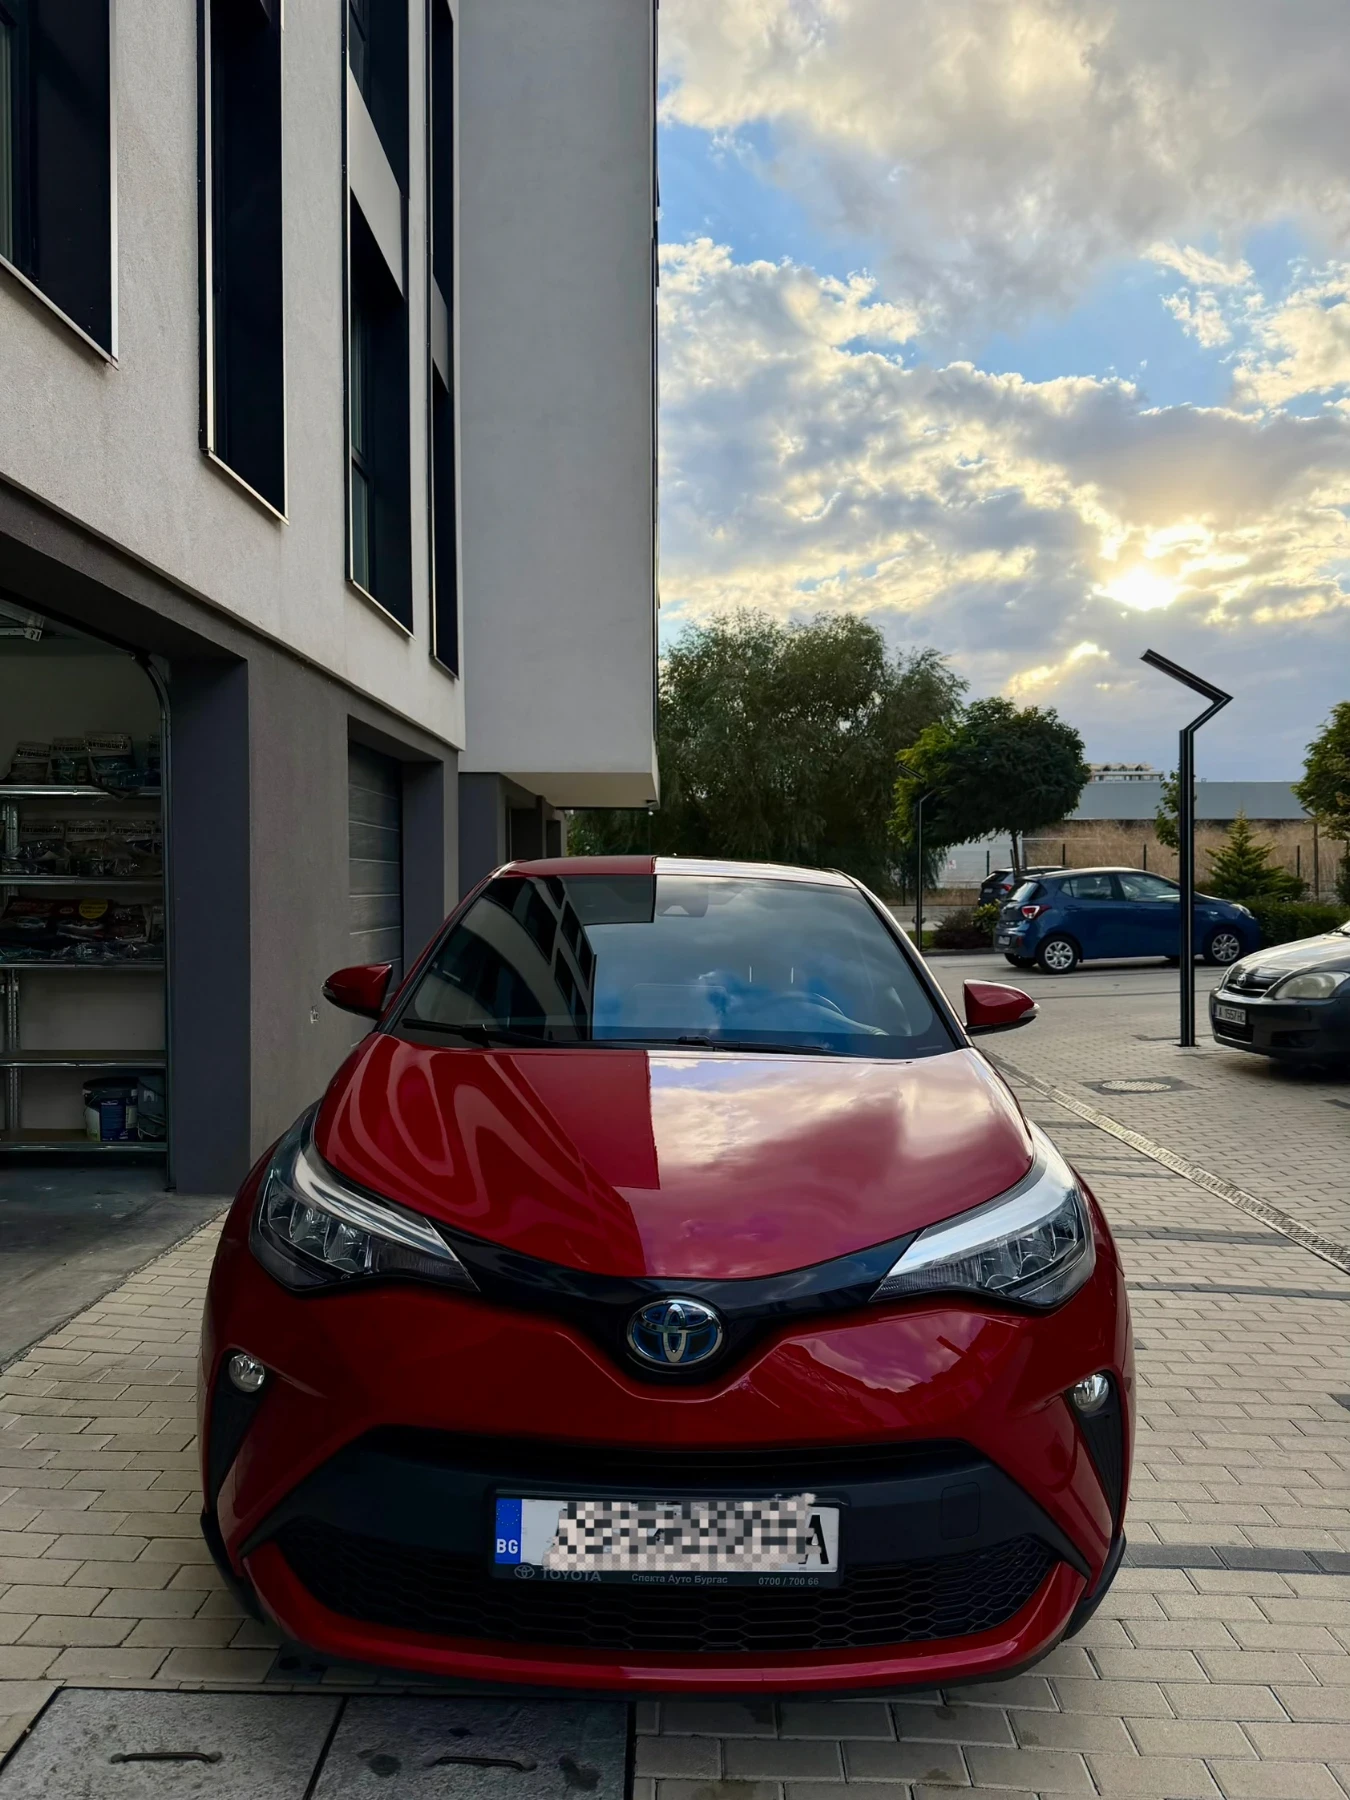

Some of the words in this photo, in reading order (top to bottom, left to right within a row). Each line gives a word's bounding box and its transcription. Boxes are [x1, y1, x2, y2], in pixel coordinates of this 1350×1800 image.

[496, 1539, 519, 1554] BG
[541, 1569, 602, 1582] TOYOTA
[631, 1573, 666, 1583] Спекта
[667, 1574, 692, 1585] Ауто
[694, 1575, 728, 1585] Бургас
[758, 1577, 781, 1586] 0700
[789, 1577, 806, 1586] 700
[808, 1577, 820, 1586] 66
